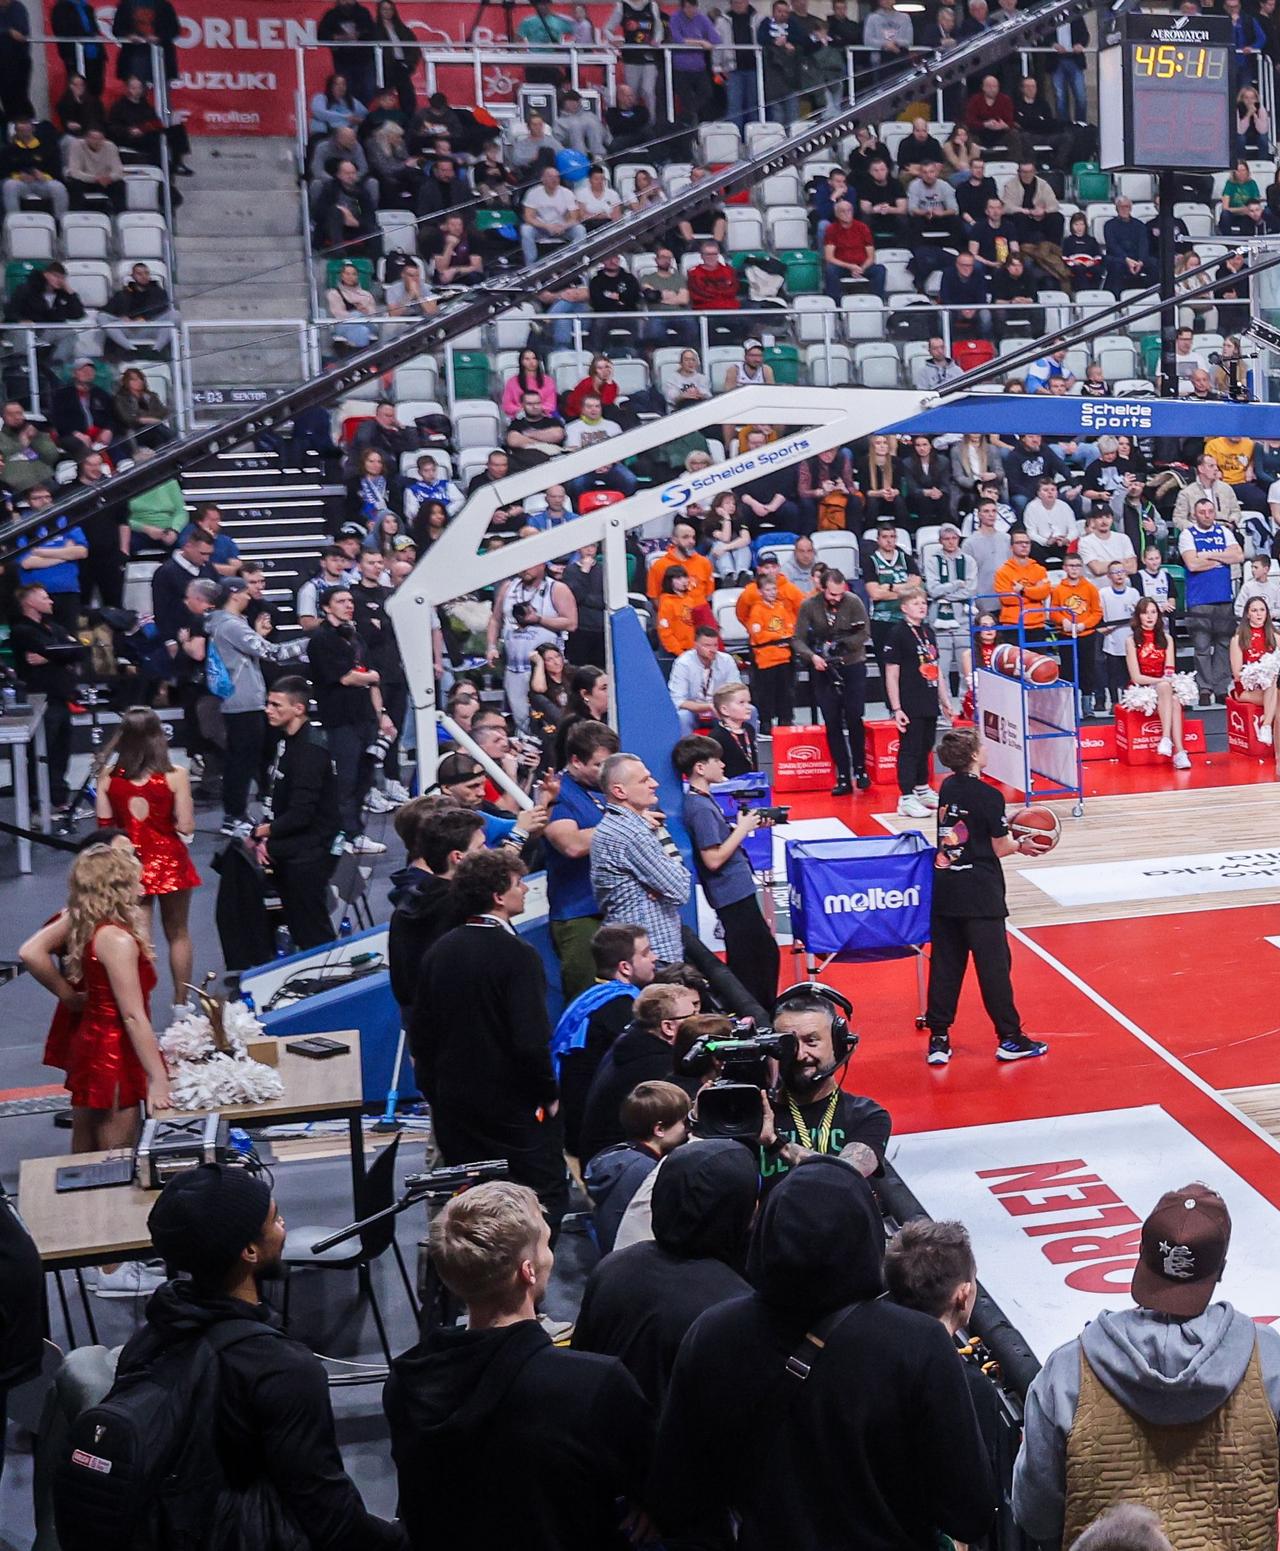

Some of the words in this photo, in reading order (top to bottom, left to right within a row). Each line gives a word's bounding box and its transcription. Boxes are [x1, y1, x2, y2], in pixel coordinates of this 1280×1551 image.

[174, 16, 318, 49] ORLEN
[1151, 29, 1210, 40] AEROWATCH
[204, 110, 261, 124] molten
[975, 158, 1144, 294] ORLEN
[1081, 402, 1153, 417] Schelde
[1081, 415, 1152, 430] Sports
[691, 460, 756, 490] Schelde
[757, 438, 810, 463] Sports
[824, 887, 920, 915] molten
